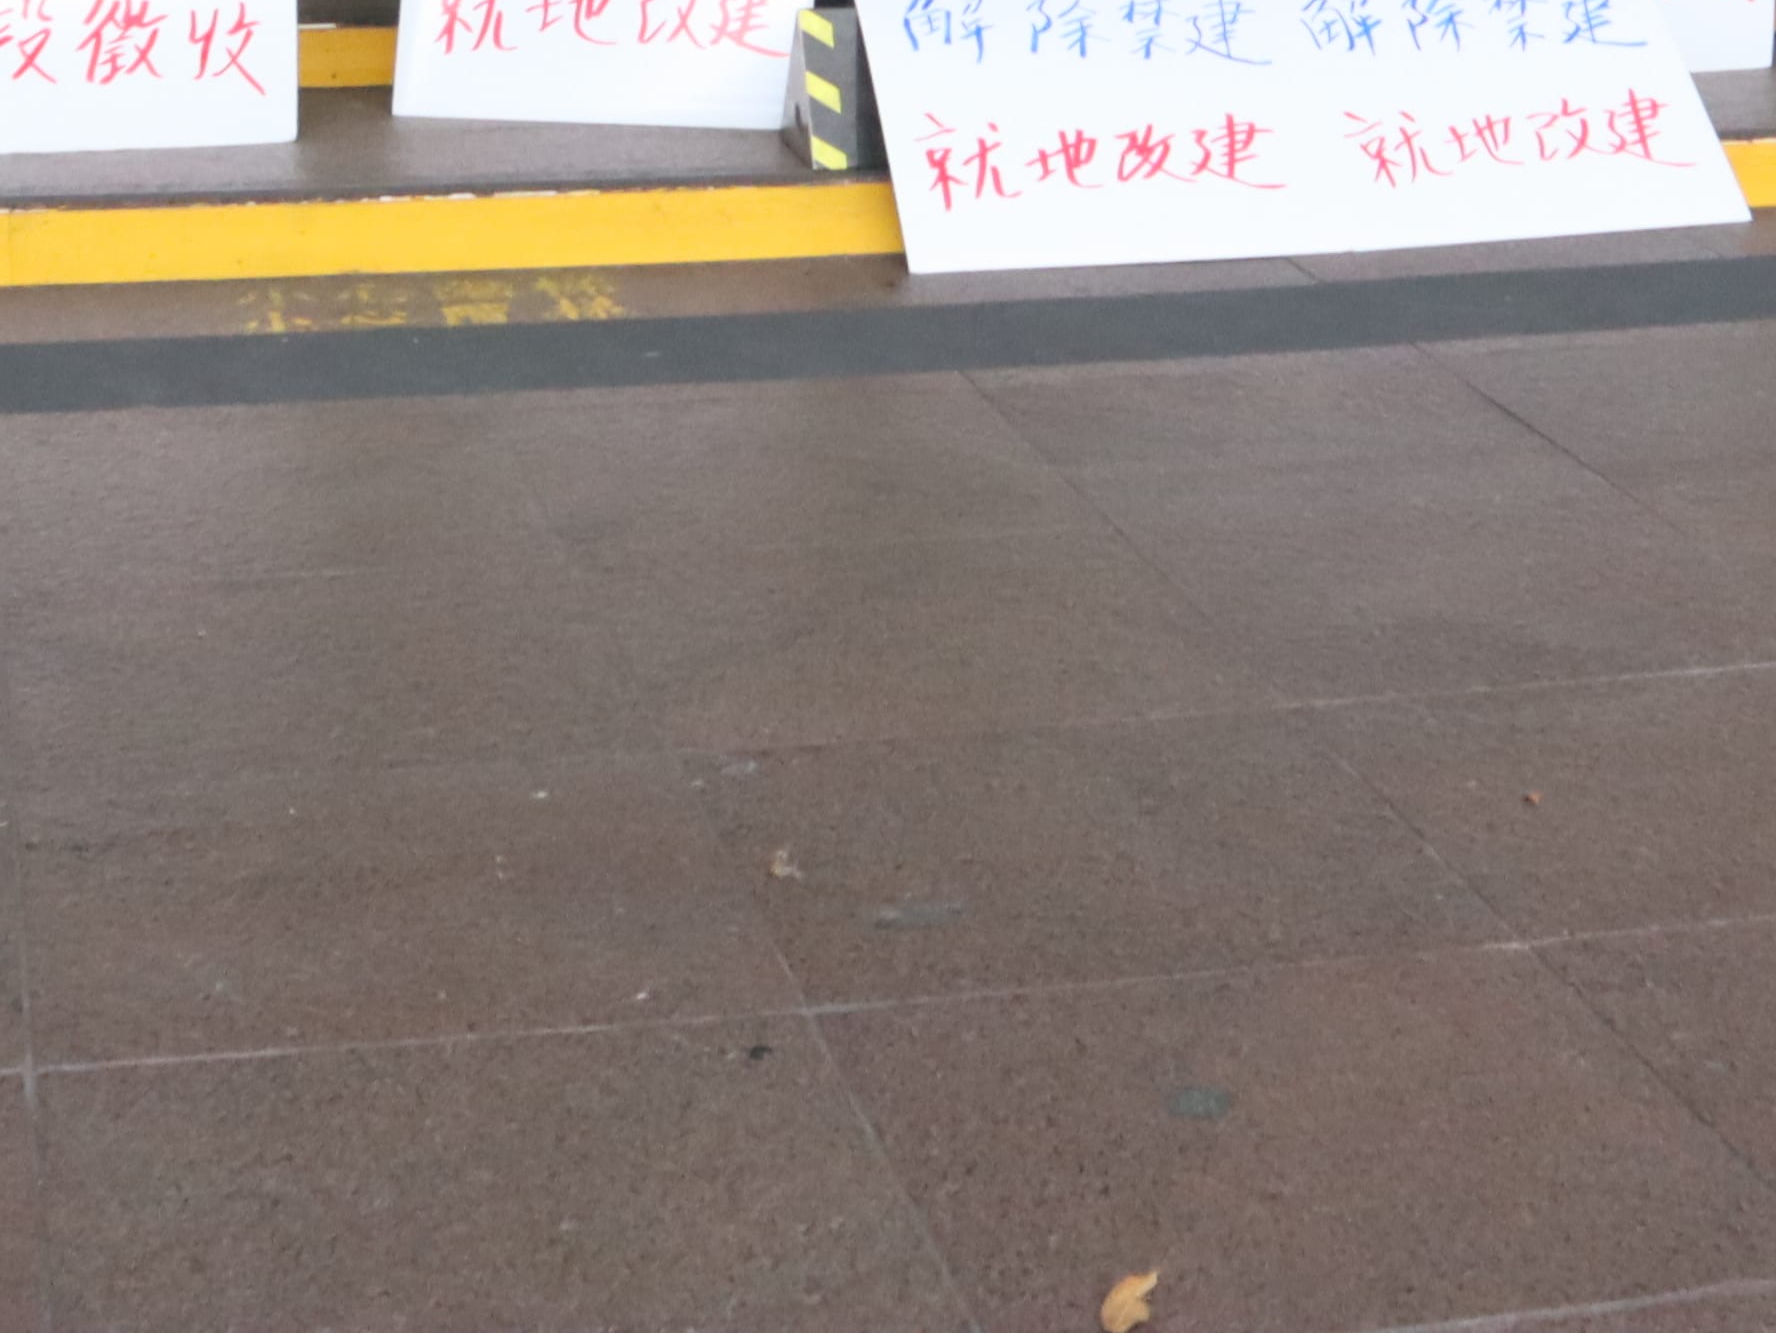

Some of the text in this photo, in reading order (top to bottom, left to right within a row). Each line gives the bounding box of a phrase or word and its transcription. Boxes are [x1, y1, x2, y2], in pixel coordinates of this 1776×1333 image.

[914, 112, 1288, 213] 就地改建
[1342, 87, 1698, 191] 就地改建
